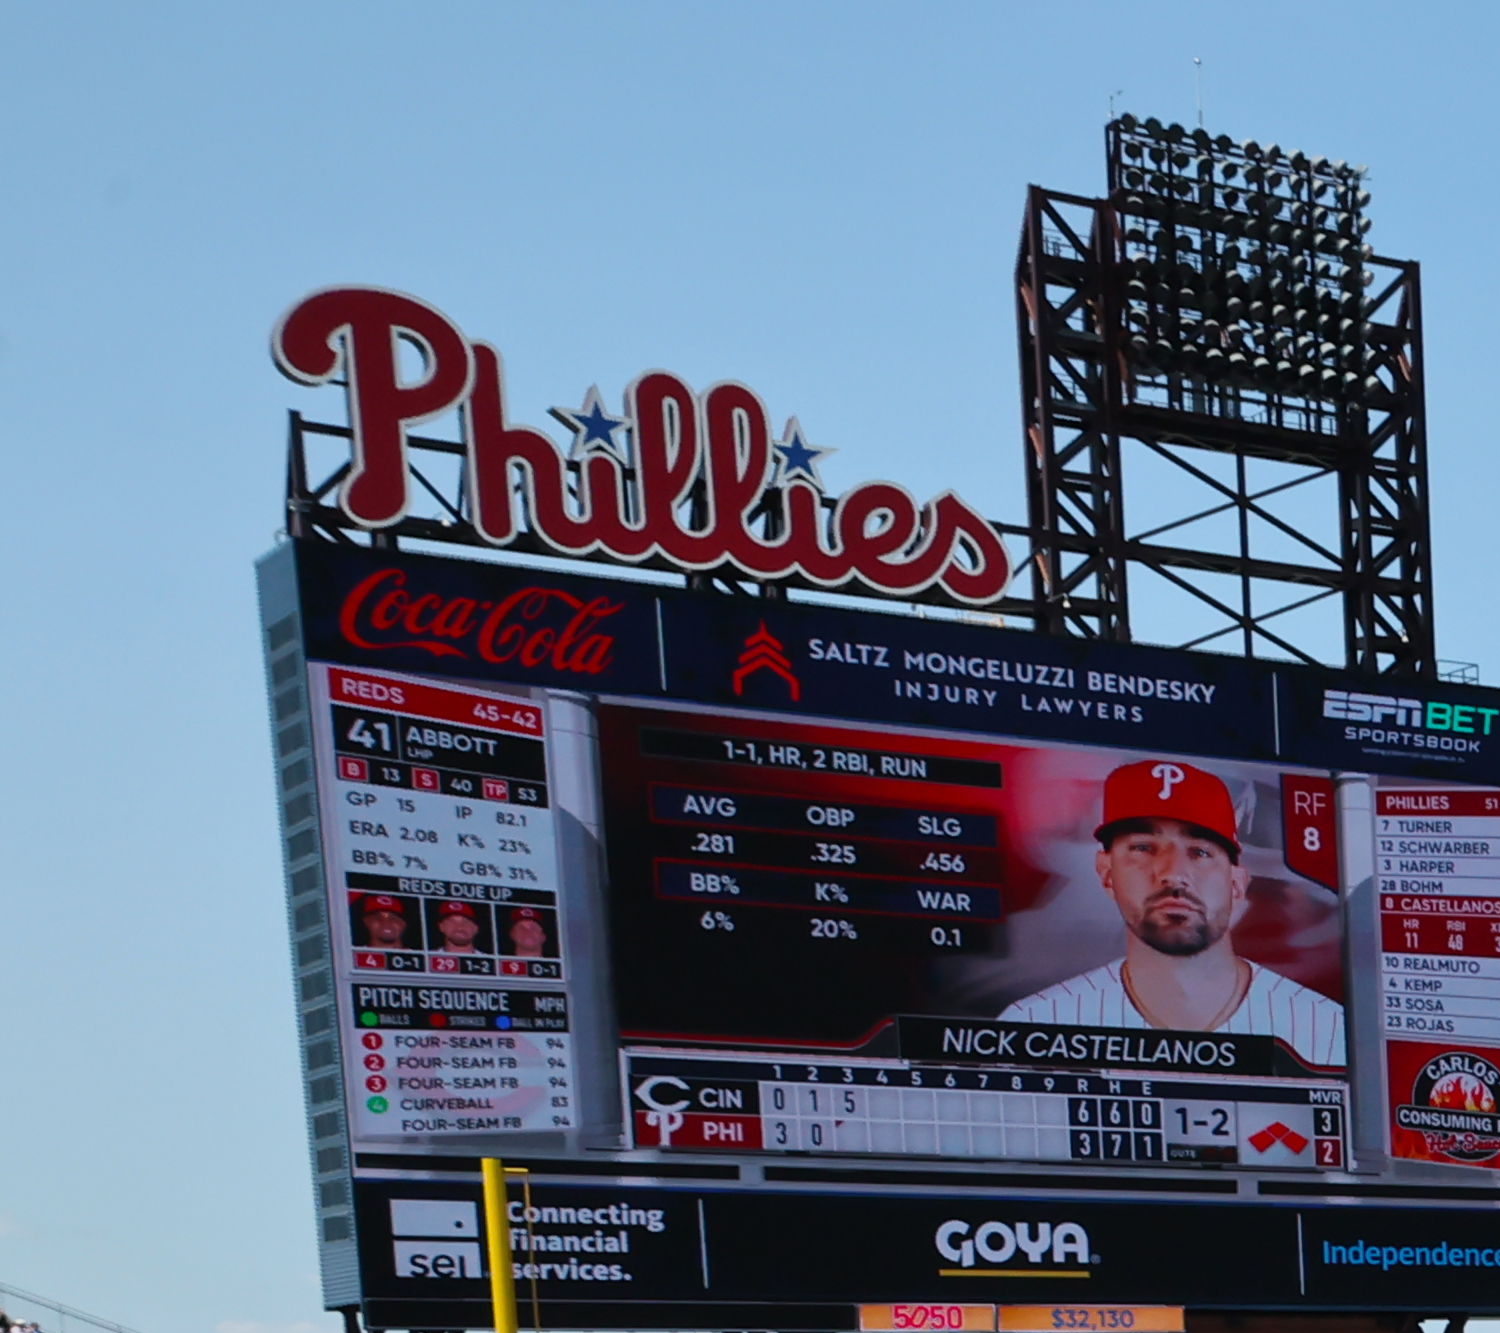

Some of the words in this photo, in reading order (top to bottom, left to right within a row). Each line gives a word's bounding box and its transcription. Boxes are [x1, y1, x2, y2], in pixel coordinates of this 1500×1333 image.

[272, 283, 1012, 604] Phillies
[338, 567, 626, 675] Coca-Cola
[808, 638, 890, 668] SALTZ
[903, 650, 1075, 689] MONGELUZZI
[1087, 672, 1217, 705] BENDESKY
[342, 677, 405, 705] REDS
[472, 703, 537, 730] 45-42
[894, 680, 998, 708] INJURY
[1020, 693, 1145, 723] LAWYERS
[1425, 702, 1500, 736] BET
[347, 718, 392, 751] 41
[406, 726, 498, 757] ABBOTT
[1343, 726, 1481, 754] SPORTSBOOK
[812, 749, 826, 768] 2
[881, 757, 927, 779] RUN
[1385, 795, 1450, 810] PHILLIES
[683, 795, 737, 818] AVG
[806, 805, 855, 828] OBP
[918, 815, 962, 838] SLG
[1398, 820, 1453, 834] TURNER
[690, 833, 735, 854] .281
[810, 843, 857, 865] .325
[920, 853, 965, 874] .456
[1398, 841, 1491, 855] SCHWARBER
[1399, 860, 1455, 874] HARPER
[1400, 879, 1444, 893] BOHM
[1403, 957, 1480, 974] REALMUTO
[1404, 978, 1443, 992] KEMP
[359, 986, 413, 1009] PITCH
[418, 989, 510, 1013] SEQUENCE
[1405, 998, 1445, 1013] SOSA
[1405, 1016, 1455, 1033] ROJAS
[941, 1027, 1018, 1057] NICK
[1024, 1031, 1236, 1068] CASTELLANOS
[698, 1087, 743, 1109] CIN
[703, 1120, 744, 1142] PHI
[1175, 1106, 1229, 1136] 1-2
[1399, 1109, 1493, 1132] CONSUMING
[505, 1200, 665, 1232] Connecting
[509, 1229, 628, 1254] financial
[935, 1219, 1090, 1268] GOYA
[509, 1260, 633, 1282] services.
[1052, 1308, 1135, 1331] $32,130
